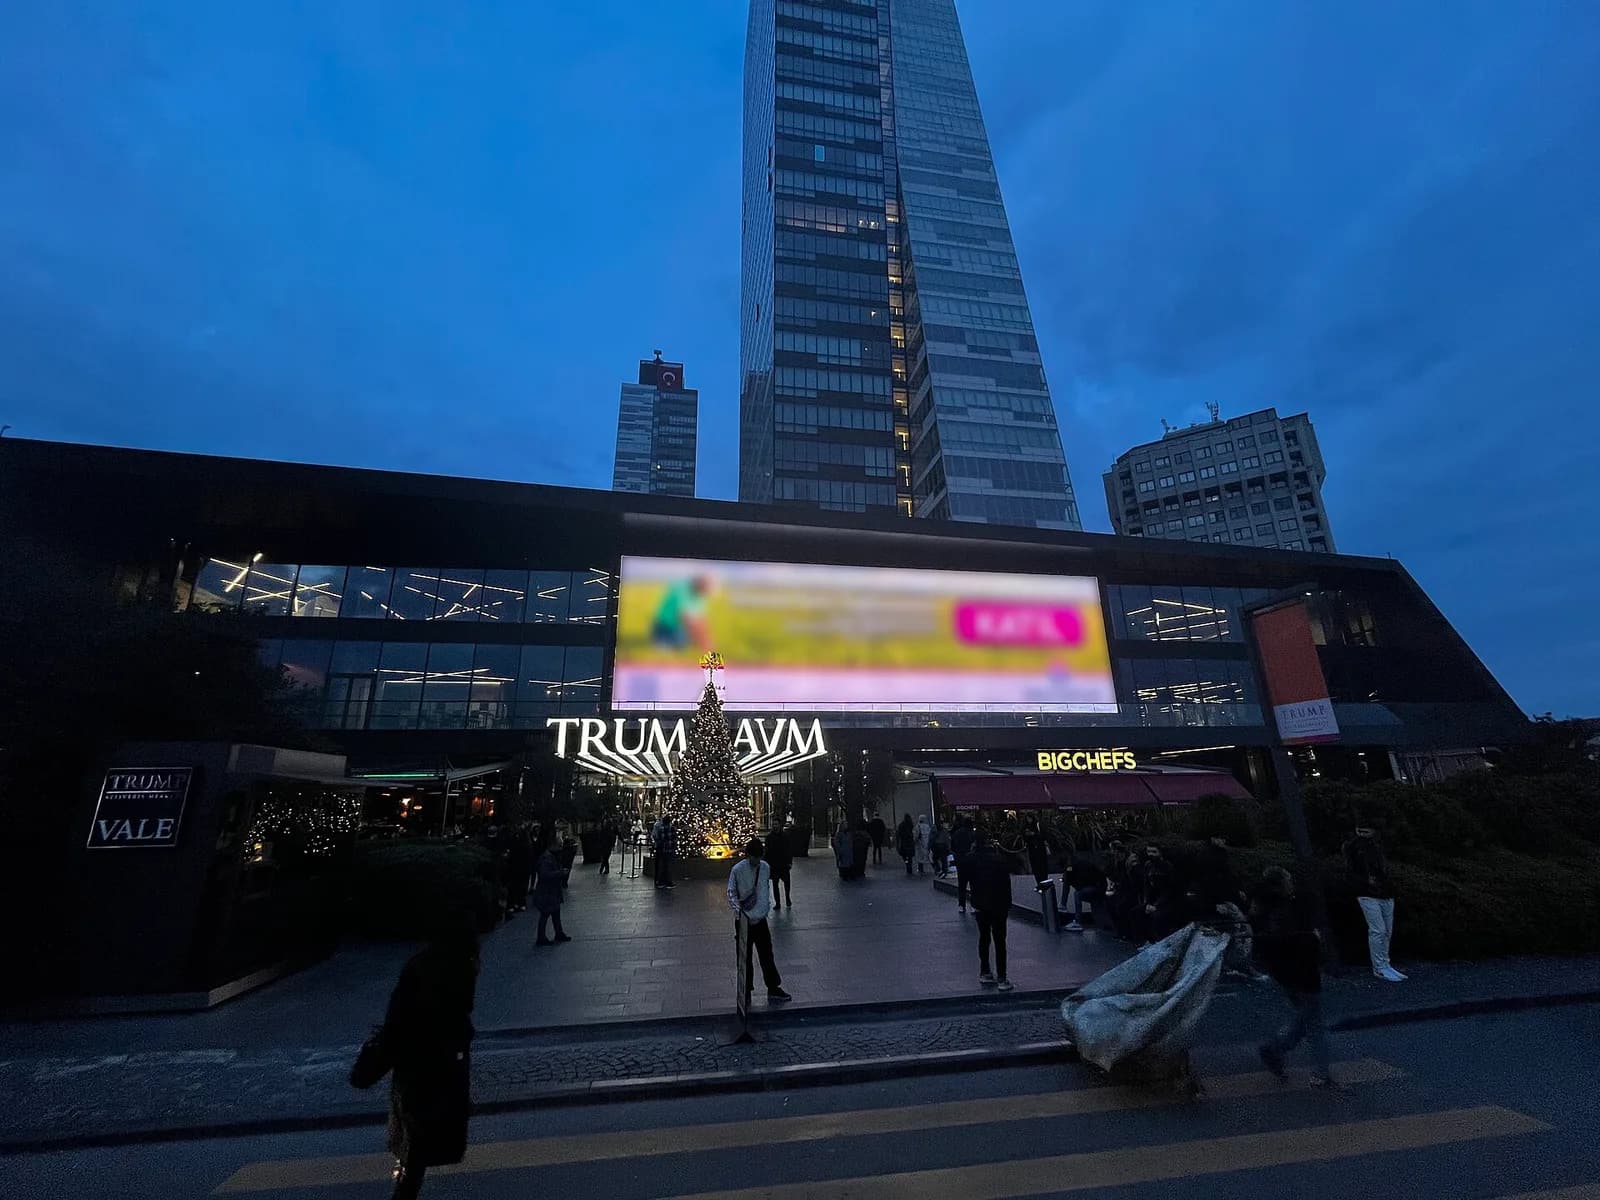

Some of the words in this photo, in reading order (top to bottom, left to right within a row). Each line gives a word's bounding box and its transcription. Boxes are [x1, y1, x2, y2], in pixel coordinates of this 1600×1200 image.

[546, 717, 687, 757] TRUM
[734, 718, 828, 754] AVM
[1037, 752, 1137, 771] BIGCHEFS
[97, 818, 175, 841] VALE
